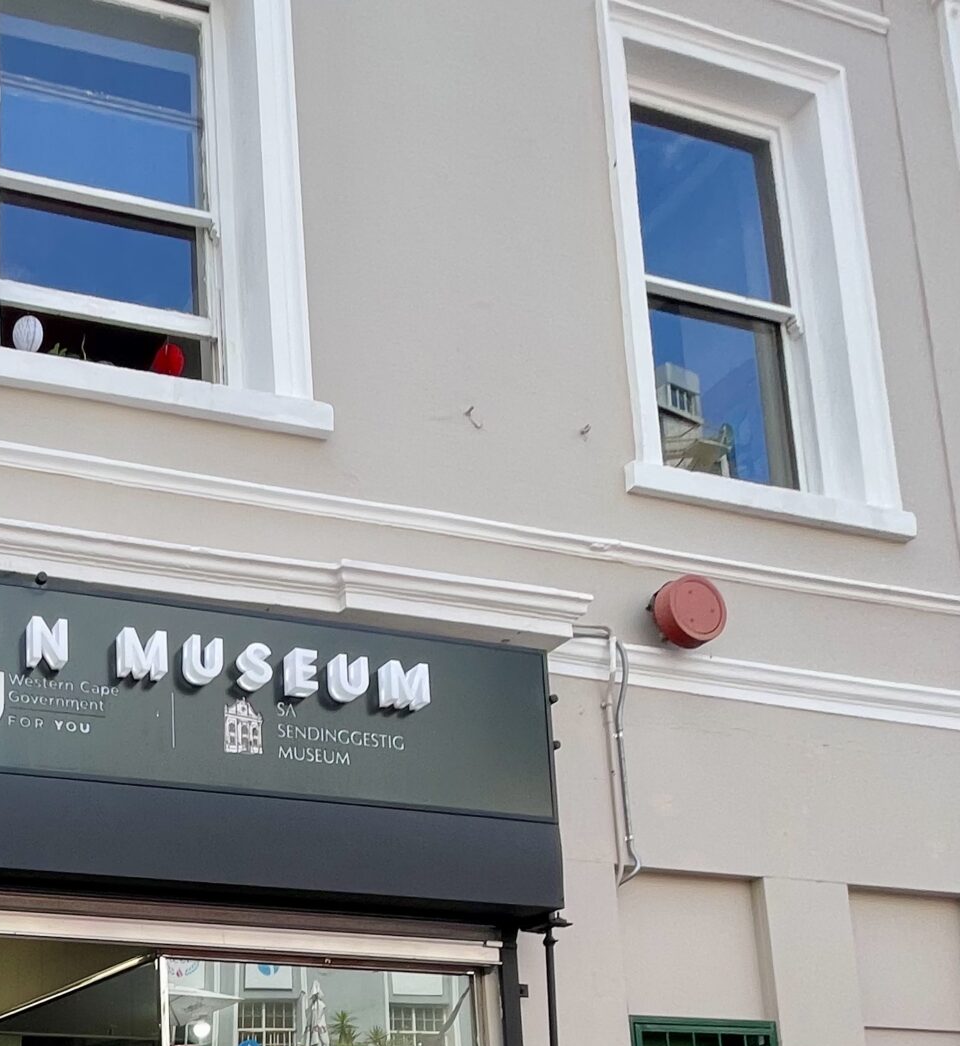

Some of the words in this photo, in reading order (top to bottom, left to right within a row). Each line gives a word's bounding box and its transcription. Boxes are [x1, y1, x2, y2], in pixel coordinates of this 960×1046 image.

[116, 626, 431, 711] MUSEUM
[8, 672, 74, 691] Western
[80, 681, 120, 697] Cape
[8, 690, 105, 711] Government
[276, 702, 297, 718] SA
[8, 715, 44, 729] FOR
[54, 719, 91, 734] YOU
[278, 723, 405, 751] SENDINGGESTIG
[278, 745, 351, 766] MUSEUM
